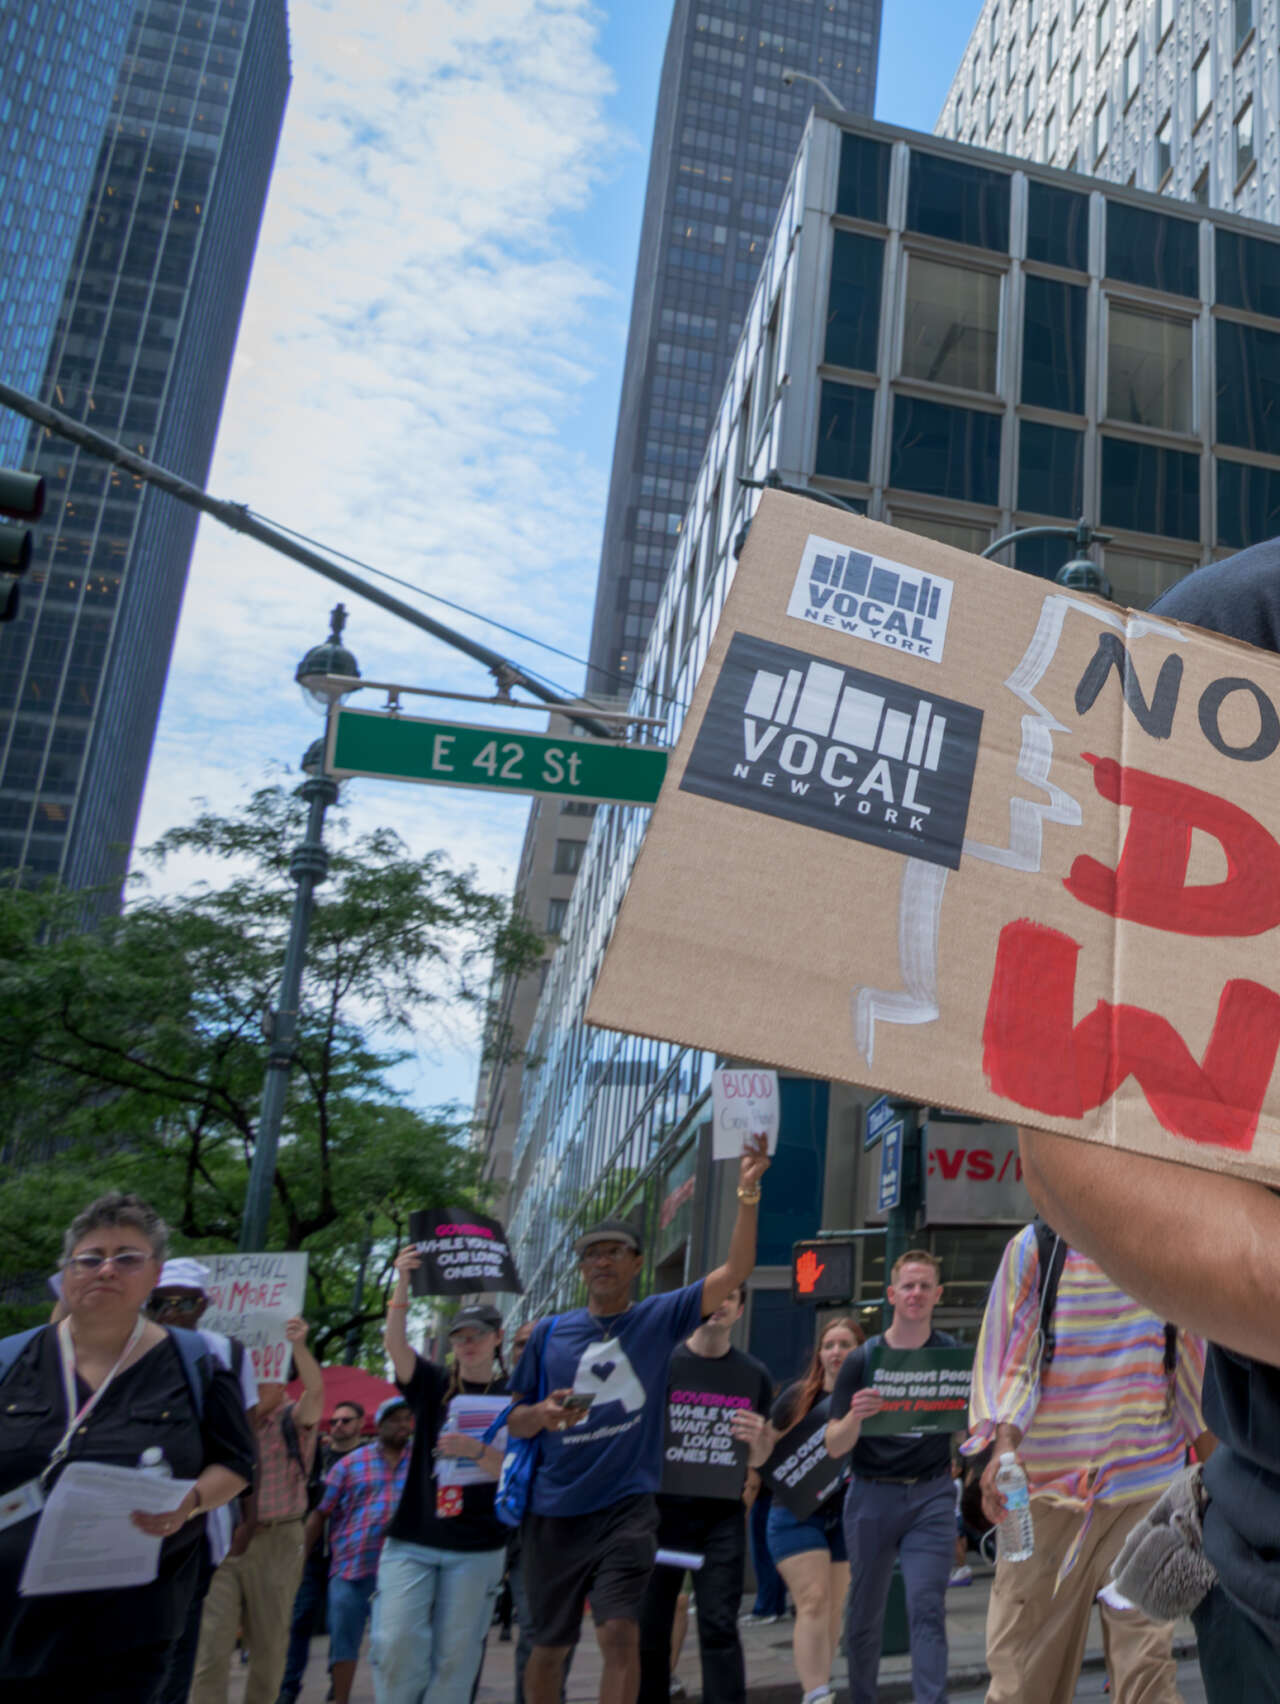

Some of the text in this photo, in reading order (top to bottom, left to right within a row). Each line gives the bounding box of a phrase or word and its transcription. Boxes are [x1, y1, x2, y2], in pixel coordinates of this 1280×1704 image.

[809, 582, 933, 644] VOCAL
[804, 608, 931, 656] NEW YORK
[432, 734, 582, 785] E 42 St
[743, 718, 931, 815] VOCAL
[732, 763, 923, 831] NEW YORK
[722, 1072, 773, 1099] BLOOD
[416, 1238, 464, 1253] WHILE
[437, 1251, 469, 1266] OUR
[443, 1265, 482, 1280] ONES
[228, 1281, 288, 1313] MORE
[874, 1368, 938, 1384] Support
[908, 1385, 937, 1397] Use
[669, 1404, 719, 1420] WHILE
[671, 1419, 710, 1434] WAIT,
[682, 1434, 732, 1450] LOVED
[665, 1446, 736, 1466] ONES DIE.
[773, 1455, 799, 1481] END
